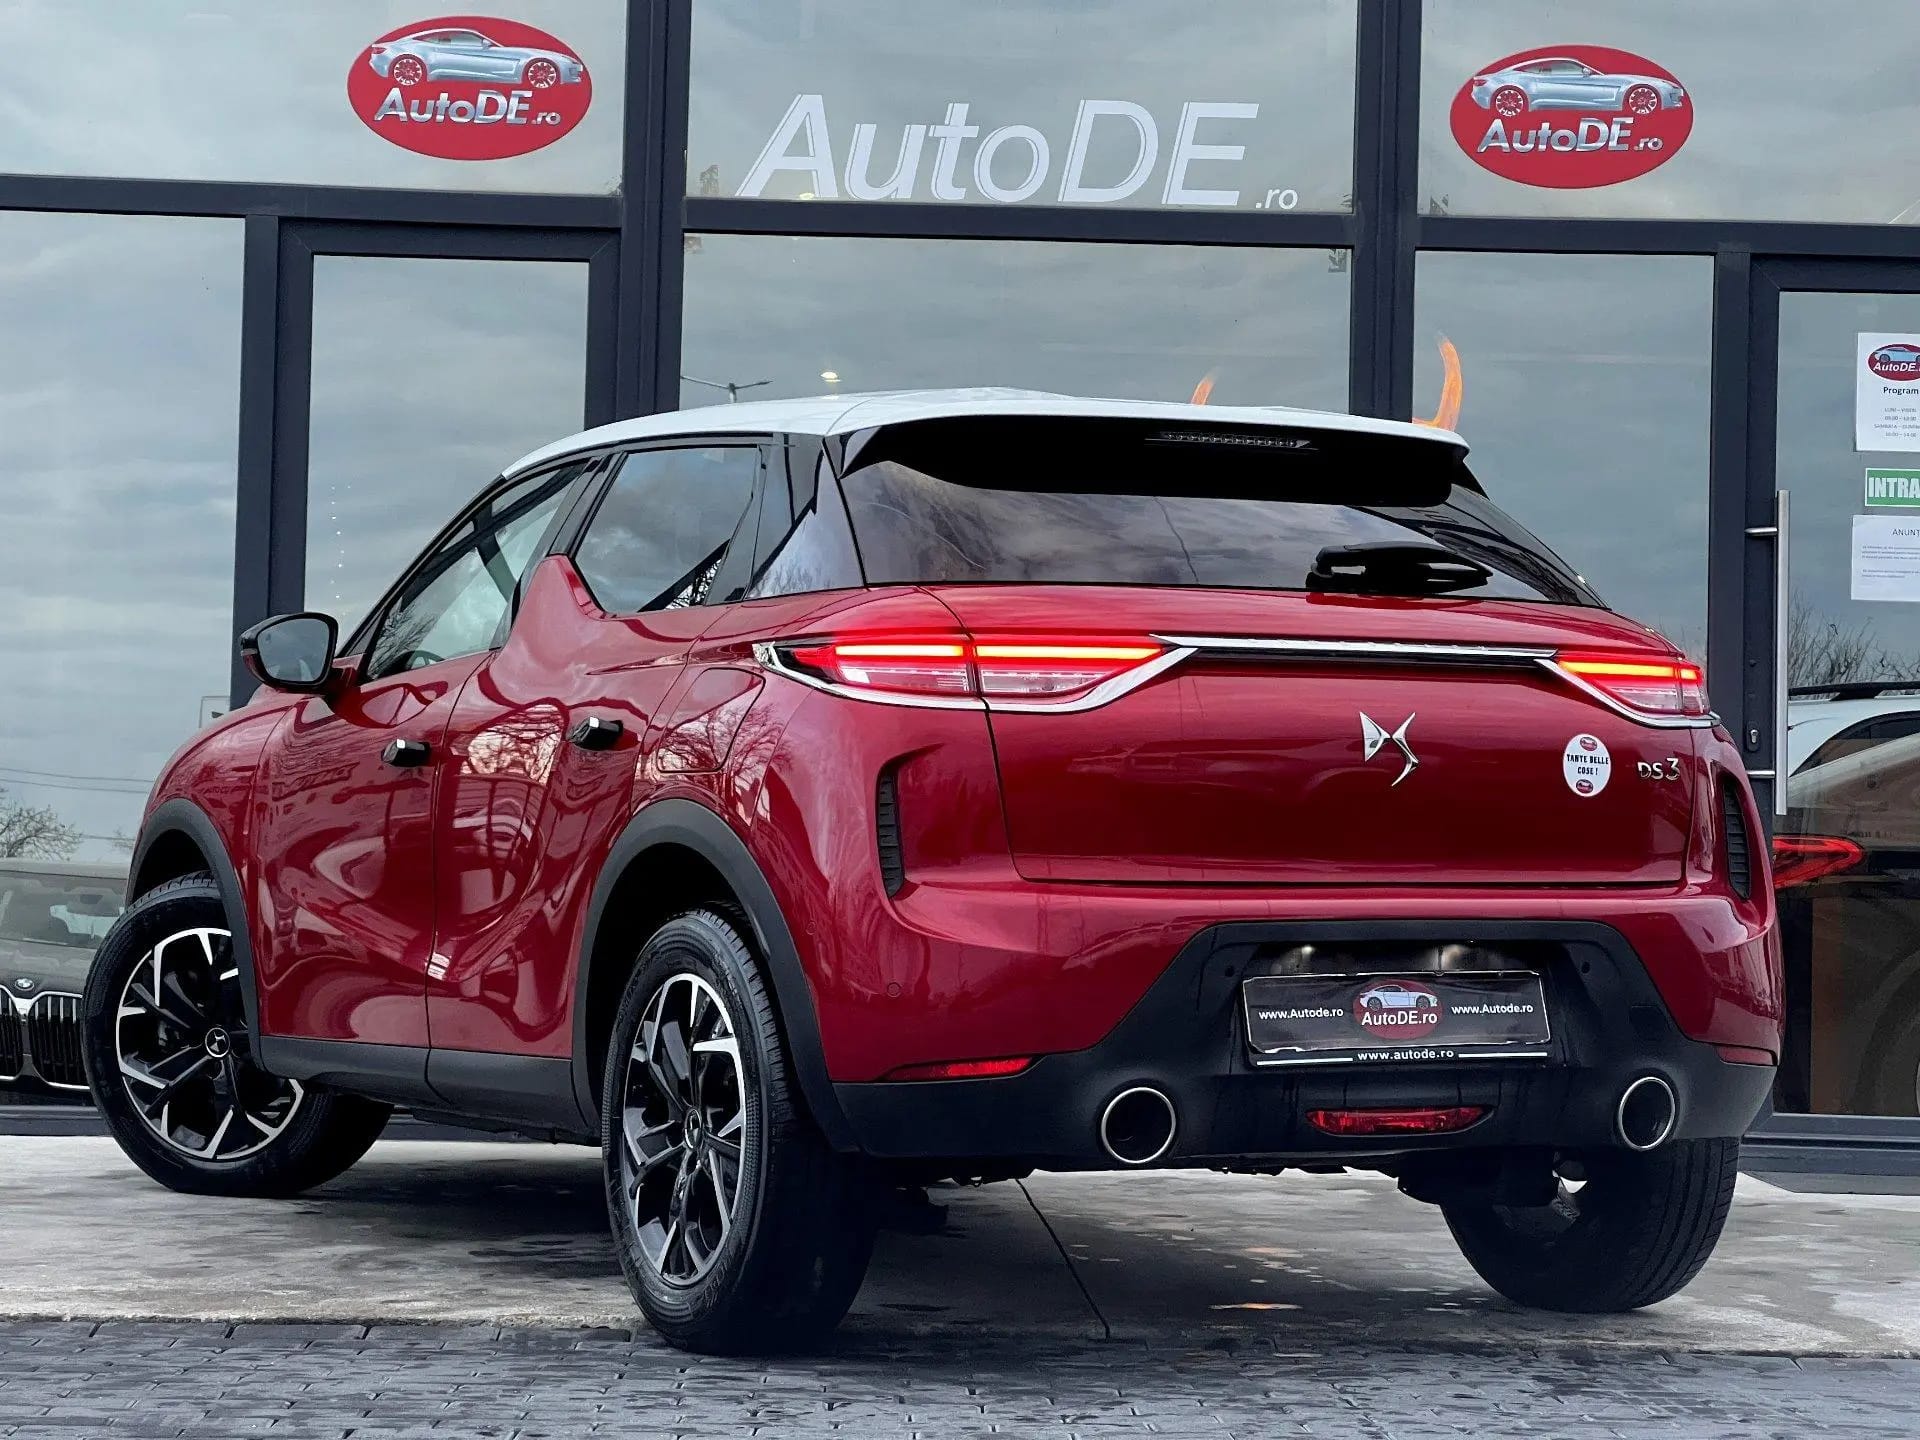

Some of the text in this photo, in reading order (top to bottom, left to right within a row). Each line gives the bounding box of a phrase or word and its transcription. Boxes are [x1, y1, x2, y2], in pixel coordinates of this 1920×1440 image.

[1883, 386, 1919, 396] Program
[1566, 753, 1609, 765] TANTE BELLE
[1577, 766, 1594, 775] COSE
[1258, 1003, 1534, 1026] www.Autode.ro AutoDE.ro www.Autode.ro
[1357, 1048, 1454, 1062] www.autode.ro
